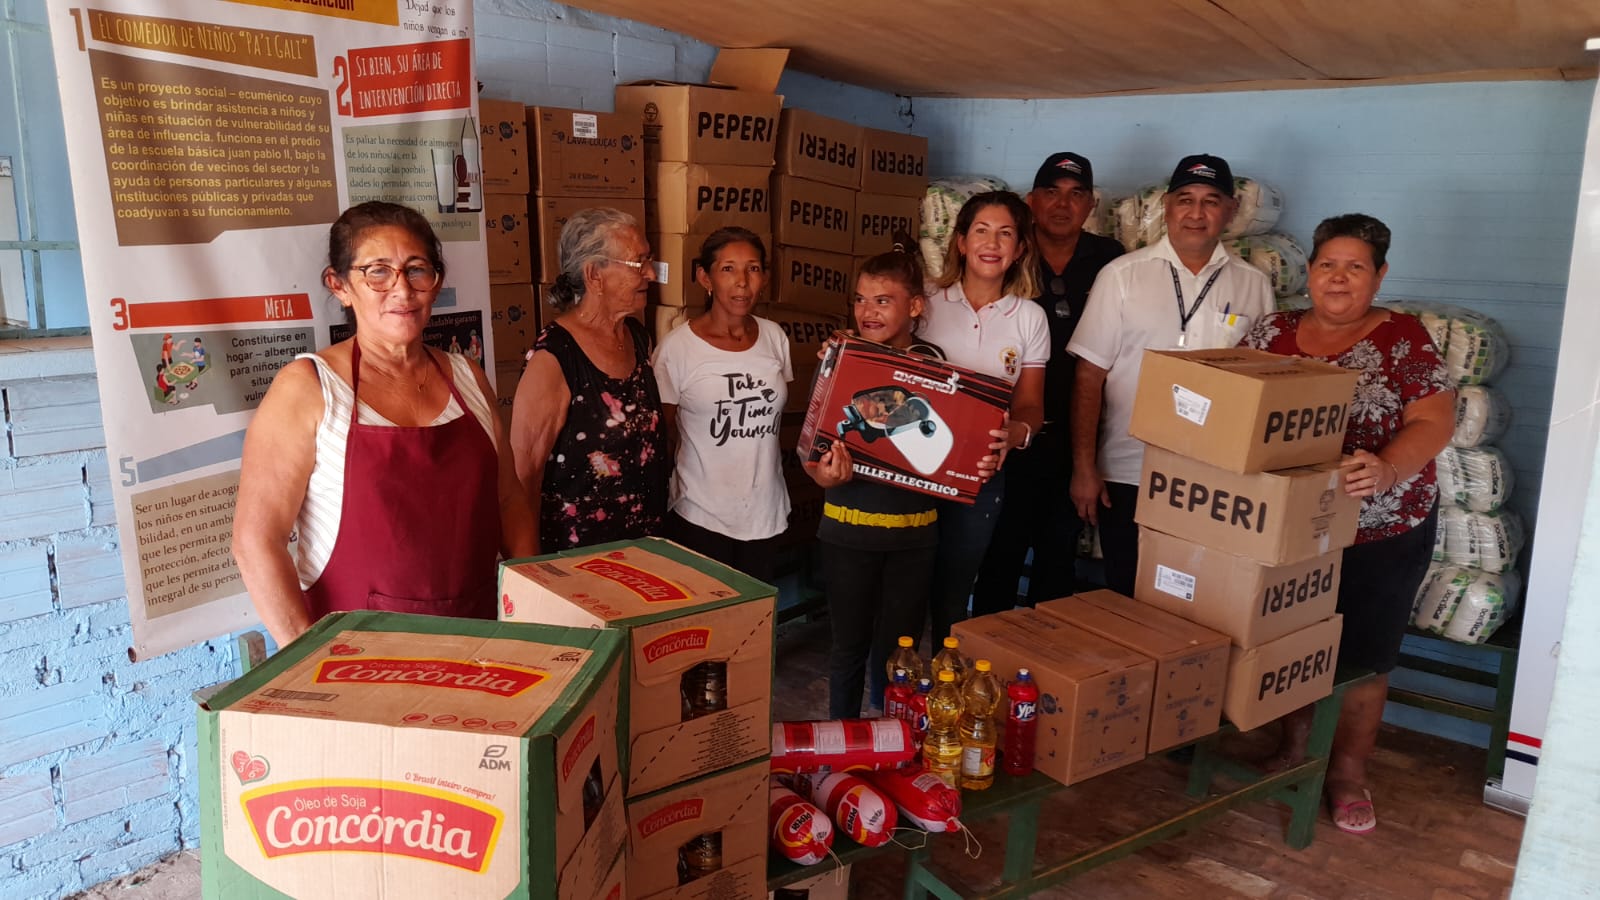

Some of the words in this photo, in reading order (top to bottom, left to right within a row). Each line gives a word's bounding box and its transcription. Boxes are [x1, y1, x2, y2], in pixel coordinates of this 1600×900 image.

[432, 5, 443, 15] que
[445, 5, 455, 16] los
[69, 8, 86, 51] 1
[116, 18, 178, 46] COMEDOR
[181, 25, 195, 48] DE
[403, 20, 425, 31] niños
[427, 24, 448, 38] vengan
[369, 57, 396, 77] BIEN,
[399, 54, 409, 72] SU
[412, 48, 431, 72] ÁREA
[432, 52, 443, 70] DE
[101, 77, 117, 89] Es
[121, 81, 134, 91] un
[138, 82, 191, 96] proyecto
[195, 87, 227, 97] social
[239, 89, 294, 102] ecuménico
[300, 94, 322, 105] cuyo
[332, 55, 352, 115] 2
[358, 80, 425, 110] INTERVENCIÓN
[427, 81, 461, 101] DIRECTA
[104, 96, 150, 108] objetivo
[153, 101, 167, 109] es
[170, 98, 213, 111] brindar
[216, 102, 268, 115] asistencia
[271, 107, 278, 116] a
[280, 106, 306, 118] niños
[309, 110, 315, 119] y
[106, 111, 138, 122] niñas
[141, 114, 154, 124] en
[157, 114, 212, 127] situación
[215, 116, 229, 128] de
[232, 117, 302, 131] vulnerabilidad
[305, 121, 316, 132] de
[318, 124, 330, 133] su
[698, 111, 774, 142] PEPERI
[108, 127, 134, 138] área
[137, 127, 150, 139] de
[216, 132, 262, 144] funciona
[265, 135, 277, 144] en
[280, 133, 288, 144] el
[291, 134, 321, 147] predio
[799, 132, 856, 168] PEPERI
[110, 143, 124, 154] de
[128, 143, 139, 155] la
[142, 144, 184, 157] escuela
[187, 146, 226, 158] básica
[228, 148, 250, 160] juan
[254, 148, 281, 160] pablo
[295, 150, 315, 161] bajo
[318, 150, 325, 160] la
[872, 149, 923, 176] PEPERI
[112, 159, 186, 172] coordinación
[190, 160, 204, 172] de
[207, 162, 249, 173] vecinos
[252, 162, 267, 173] del
[270, 163, 301, 173] sector
[303, 165, 310, 176] y
[312, 163, 320, 173] la
[114, 176, 150, 189] ayuda
[153, 176, 166, 187] de
[169, 178, 221, 189] personas
[224, 177, 285, 189] particulares
[288, 180, 294, 189] y
[296, 178, 332, 189] algunas
[115, 191, 188, 202] instituciones
[192, 190, 239, 204] públicas
[242, 193, 249, 204] y
[251, 191, 294, 203] privadas
[296, 193, 314, 203] que
[697, 186, 768, 213] PEPERI
[117, 206, 180, 219] coadyuvan
[183, 209, 189, 217] a
[192, 207, 206, 217] su
[208, 205, 293, 217] funcionamiento.
[790, 200, 848, 232] PEPERI
[791, 261, 846, 293] PEPERI
[110, 298, 129, 330] 3
[264, 297, 294, 318] META
[231, 334, 292, 348] Constituirse
[295, 332, 306, 340] en
[780, 321, 839, 343] PEPER
[226, 352, 253, 363] hogar
[264, 345, 307, 357] albergue
[230, 365, 250, 378] para
[722, 373, 766, 398] Take
[714, 400, 731, 423] To
[733, 396, 774, 426] Time
[1264, 403, 1348, 443] PEPERI
[119, 456, 136, 487] 5
[852, 463, 892, 481] RILLET
[893, 471, 958, 496] ELECTRICO
[136, 504, 152, 515] Ser
[155, 501, 168, 511] un
[170, 496, 196, 509] lugar
[198, 491, 210, 501] de
[1149, 471, 1267, 533] PEPERI
[137, 519, 152, 531] los
[155, 513, 183, 527] niños
[185, 509, 197, 520] en
[139, 529, 179, 546] bilidad,
[181, 526, 193, 536] en
[195, 521, 208, 532] un
[141, 549, 161, 563] que
[163, 545, 177, 556] les
[179, 536, 217, 552] permita
[144, 556, 199, 578] protección,
[202, 546, 230, 560] afecto
[145, 580, 164, 593] que
[166, 575, 180, 586] les
[182, 565, 220, 582] permita
[222, 560, 230, 569] el
[1262, 563, 1334, 616] PEPERI
[147, 588, 186, 608] integral
[188, 583, 199, 594] de
[201, 579, 213, 590] su
[647, 635, 704, 659] Concórdia
[326, 664, 517, 691] Concórdia
[1258, 645, 1333, 701] PEPERI
[478, 759, 511, 771] ADM
[294, 796, 321, 812] Óleo
[324, 796, 338, 808] de
[341, 794, 366, 810] Soja
[265, 807, 478, 860] Concórdia
[642, 805, 698, 836] Concórdia
